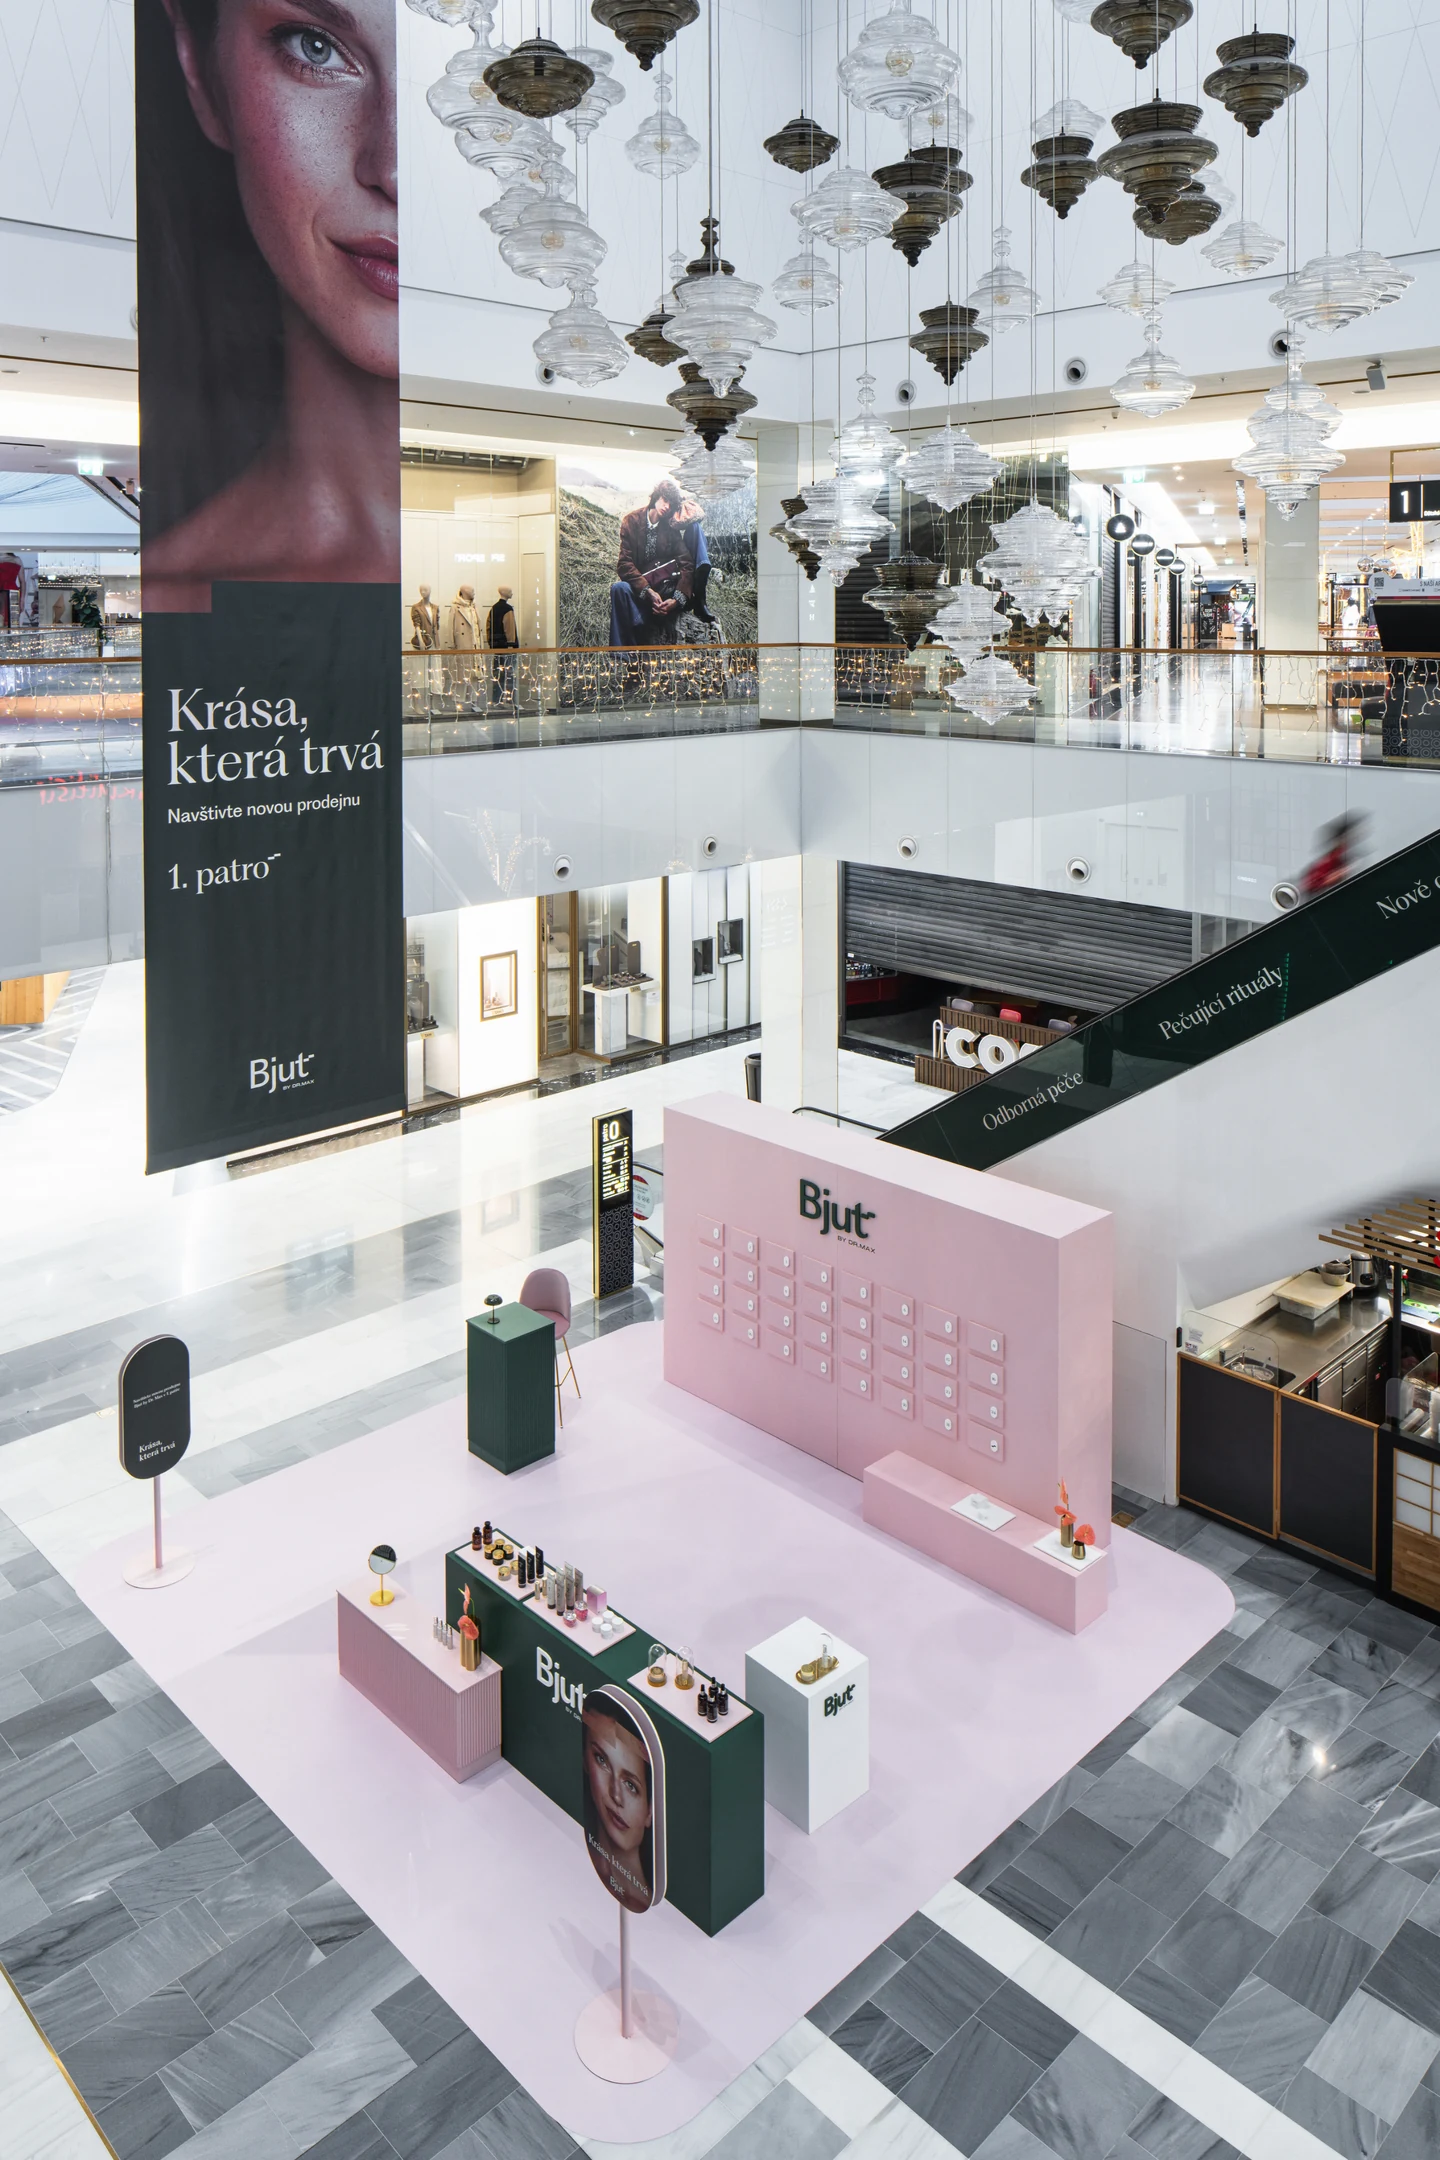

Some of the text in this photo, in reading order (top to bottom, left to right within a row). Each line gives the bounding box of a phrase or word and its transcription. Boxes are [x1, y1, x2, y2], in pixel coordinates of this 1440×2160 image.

[1400, 490, 1409, 514] 1
[167, 686, 308, 733] Krása,
[167, 730, 385, 785] která trvá
[168, 794, 360, 824] Navštivte novou prodejnu
[168, 858, 270, 895] 1. patro
[1376, 879, 1431, 919] Nově
[1158, 966, 1283, 1040] Pečující rituály
[292, 1079, 314, 1088] DR.MAX
[982, 1071, 1084, 1131] Odborná péče
[609, 1121, 620, 1140] 0
[800, 1179, 875, 1239] Bjut
[848, 1239, 875, 1254] DR.MAX
[139, 1439, 162, 1453] Krása,
[139, 1441, 176, 1461] která trvá
[824, 1684, 856, 1717] Bjut
[588, 1833, 649, 1896] Krása, která trvá
